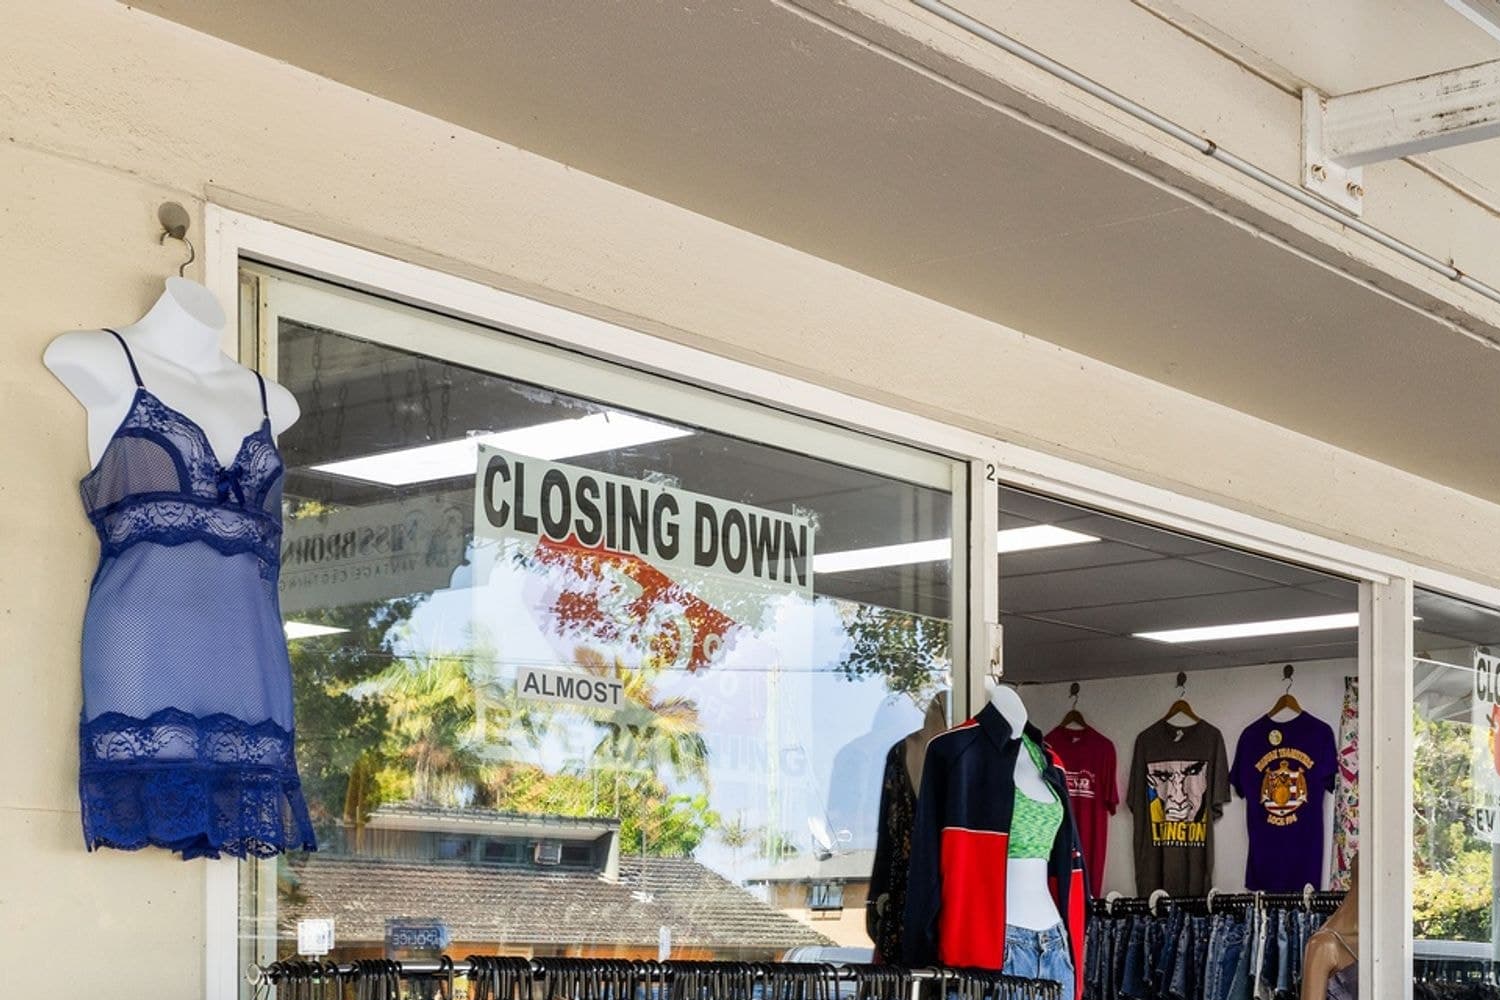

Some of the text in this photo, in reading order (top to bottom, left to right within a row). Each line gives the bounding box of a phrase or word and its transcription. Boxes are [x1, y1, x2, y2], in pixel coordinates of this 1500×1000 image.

[986, 464, 995, 481] 2
[483, 454, 807, 587] CLOSING DOWN
[522, 672, 622, 705] ALMOST
